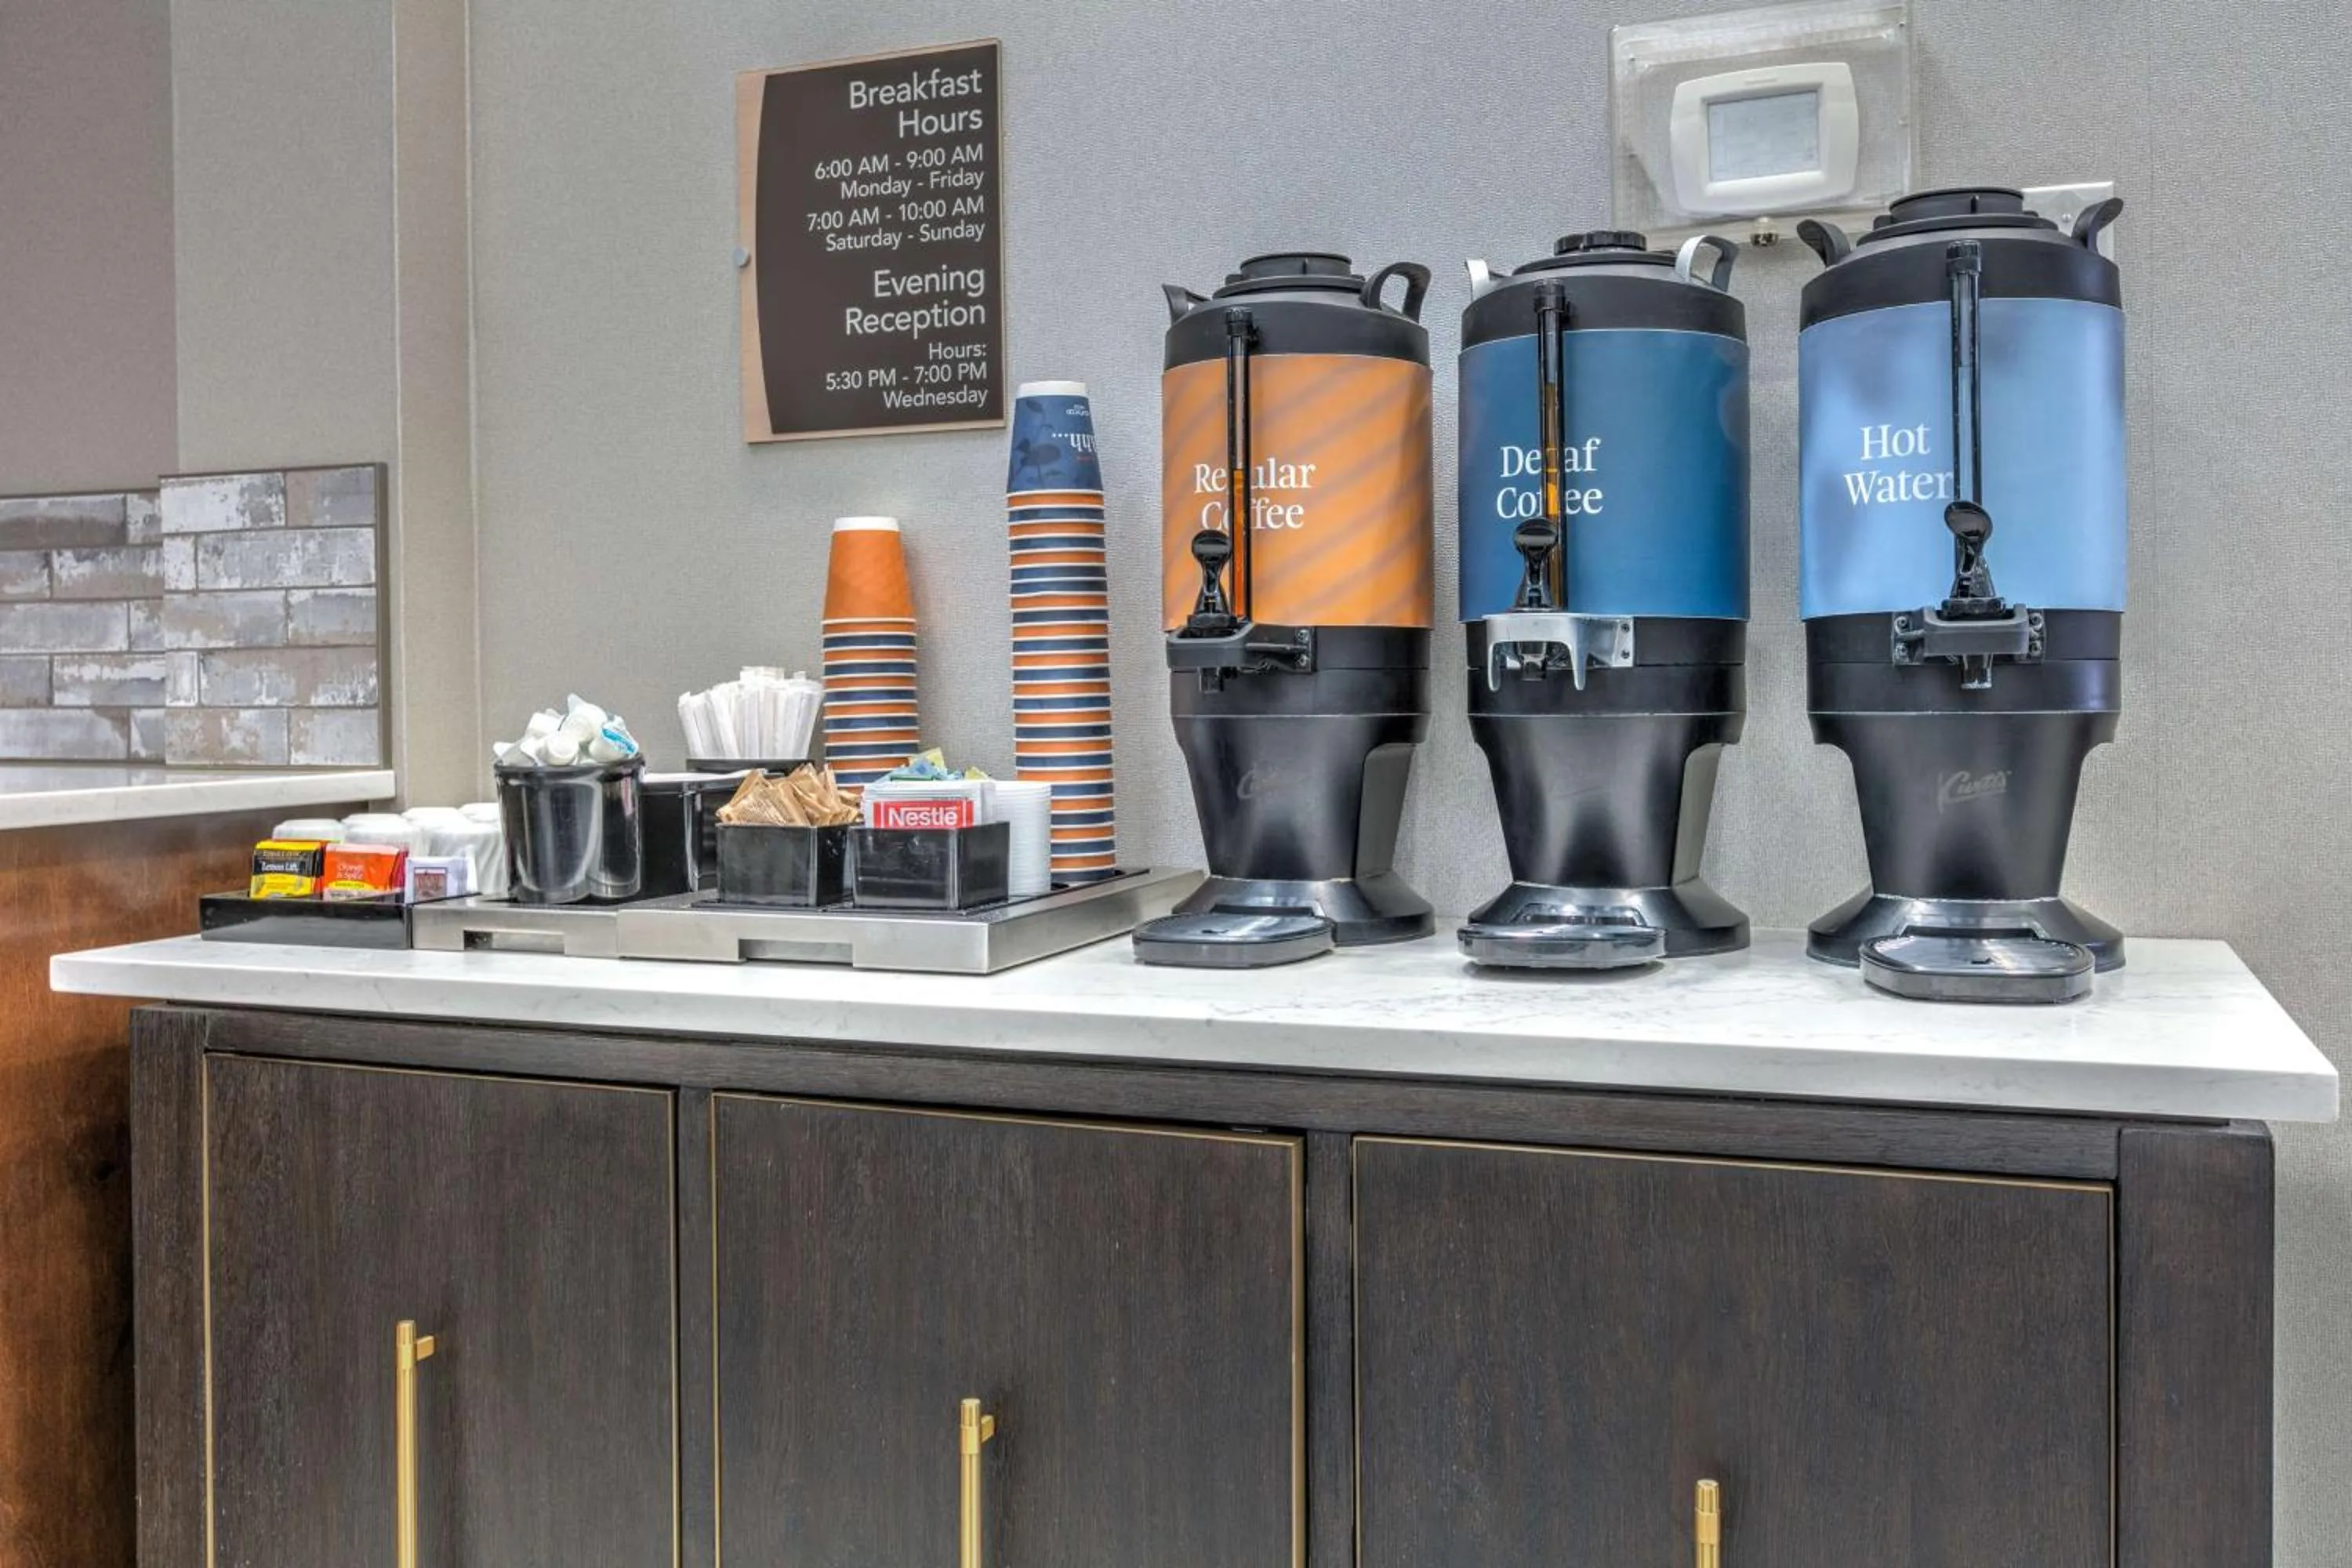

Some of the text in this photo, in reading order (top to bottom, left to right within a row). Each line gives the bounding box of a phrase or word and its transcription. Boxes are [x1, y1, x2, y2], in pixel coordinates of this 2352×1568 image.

[849, 67, 982, 109] Breakfast
[898, 108, 983, 138] Hours
[815, 158, 852, 180] 6:00
[857, 154, 888, 175] AM
[906, 147, 946, 169] 9:00
[951, 143, 983, 164] AM
[840, 176, 912, 200] Monday
[930, 168, 984, 190] Friday
[807, 211, 843, 232] 7:00
[848, 206, 879, 227] AM
[898, 200, 946, 221] 10:00
[952, 196, 984, 216] AM
[826, 227, 902, 252] Saturday
[920, 220, 985, 242] Sunday
[874, 264, 985, 298] Evening
[845, 299, 985, 339] Reception
[928, 342, 986, 360] Hours:
[826, 371, 862, 390] 5:30
[868, 368, 896, 387] PM
[913, 365, 952, 384] 7:00
[958, 361, 987, 380] PM
[884, 385, 988, 408] Wednesday
[1500, 437, 1602, 477] Deaf
[1860, 423, 1931, 460] Hot
[1193, 457, 1316, 493] Reular
[1843, 470, 1954, 507] Water
[1201, 497, 1305, 531] Cfee
